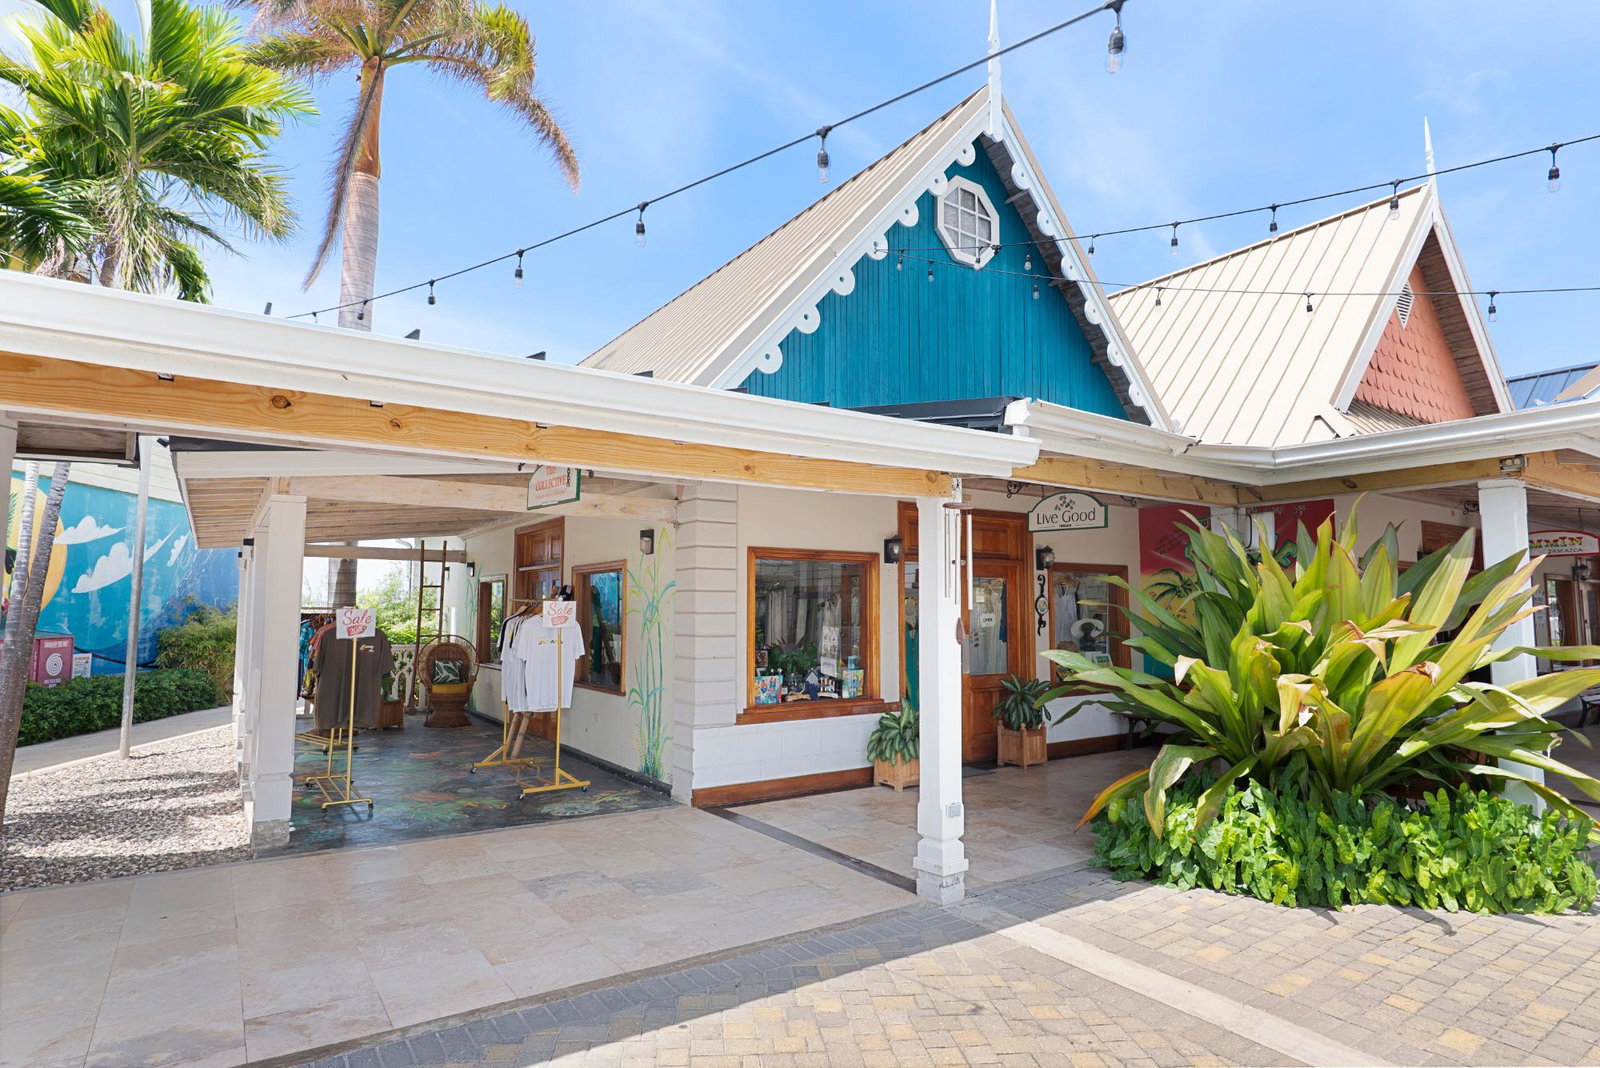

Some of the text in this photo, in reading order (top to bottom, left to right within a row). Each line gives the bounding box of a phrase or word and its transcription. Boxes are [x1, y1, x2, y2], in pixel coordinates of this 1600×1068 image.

[1036, 507, 1096, 525] Live Good
[1529, 536, 1583, 549] MMIN
[547, 602, 574, 616] Sale
[342, 609, 373, 626] Sale
